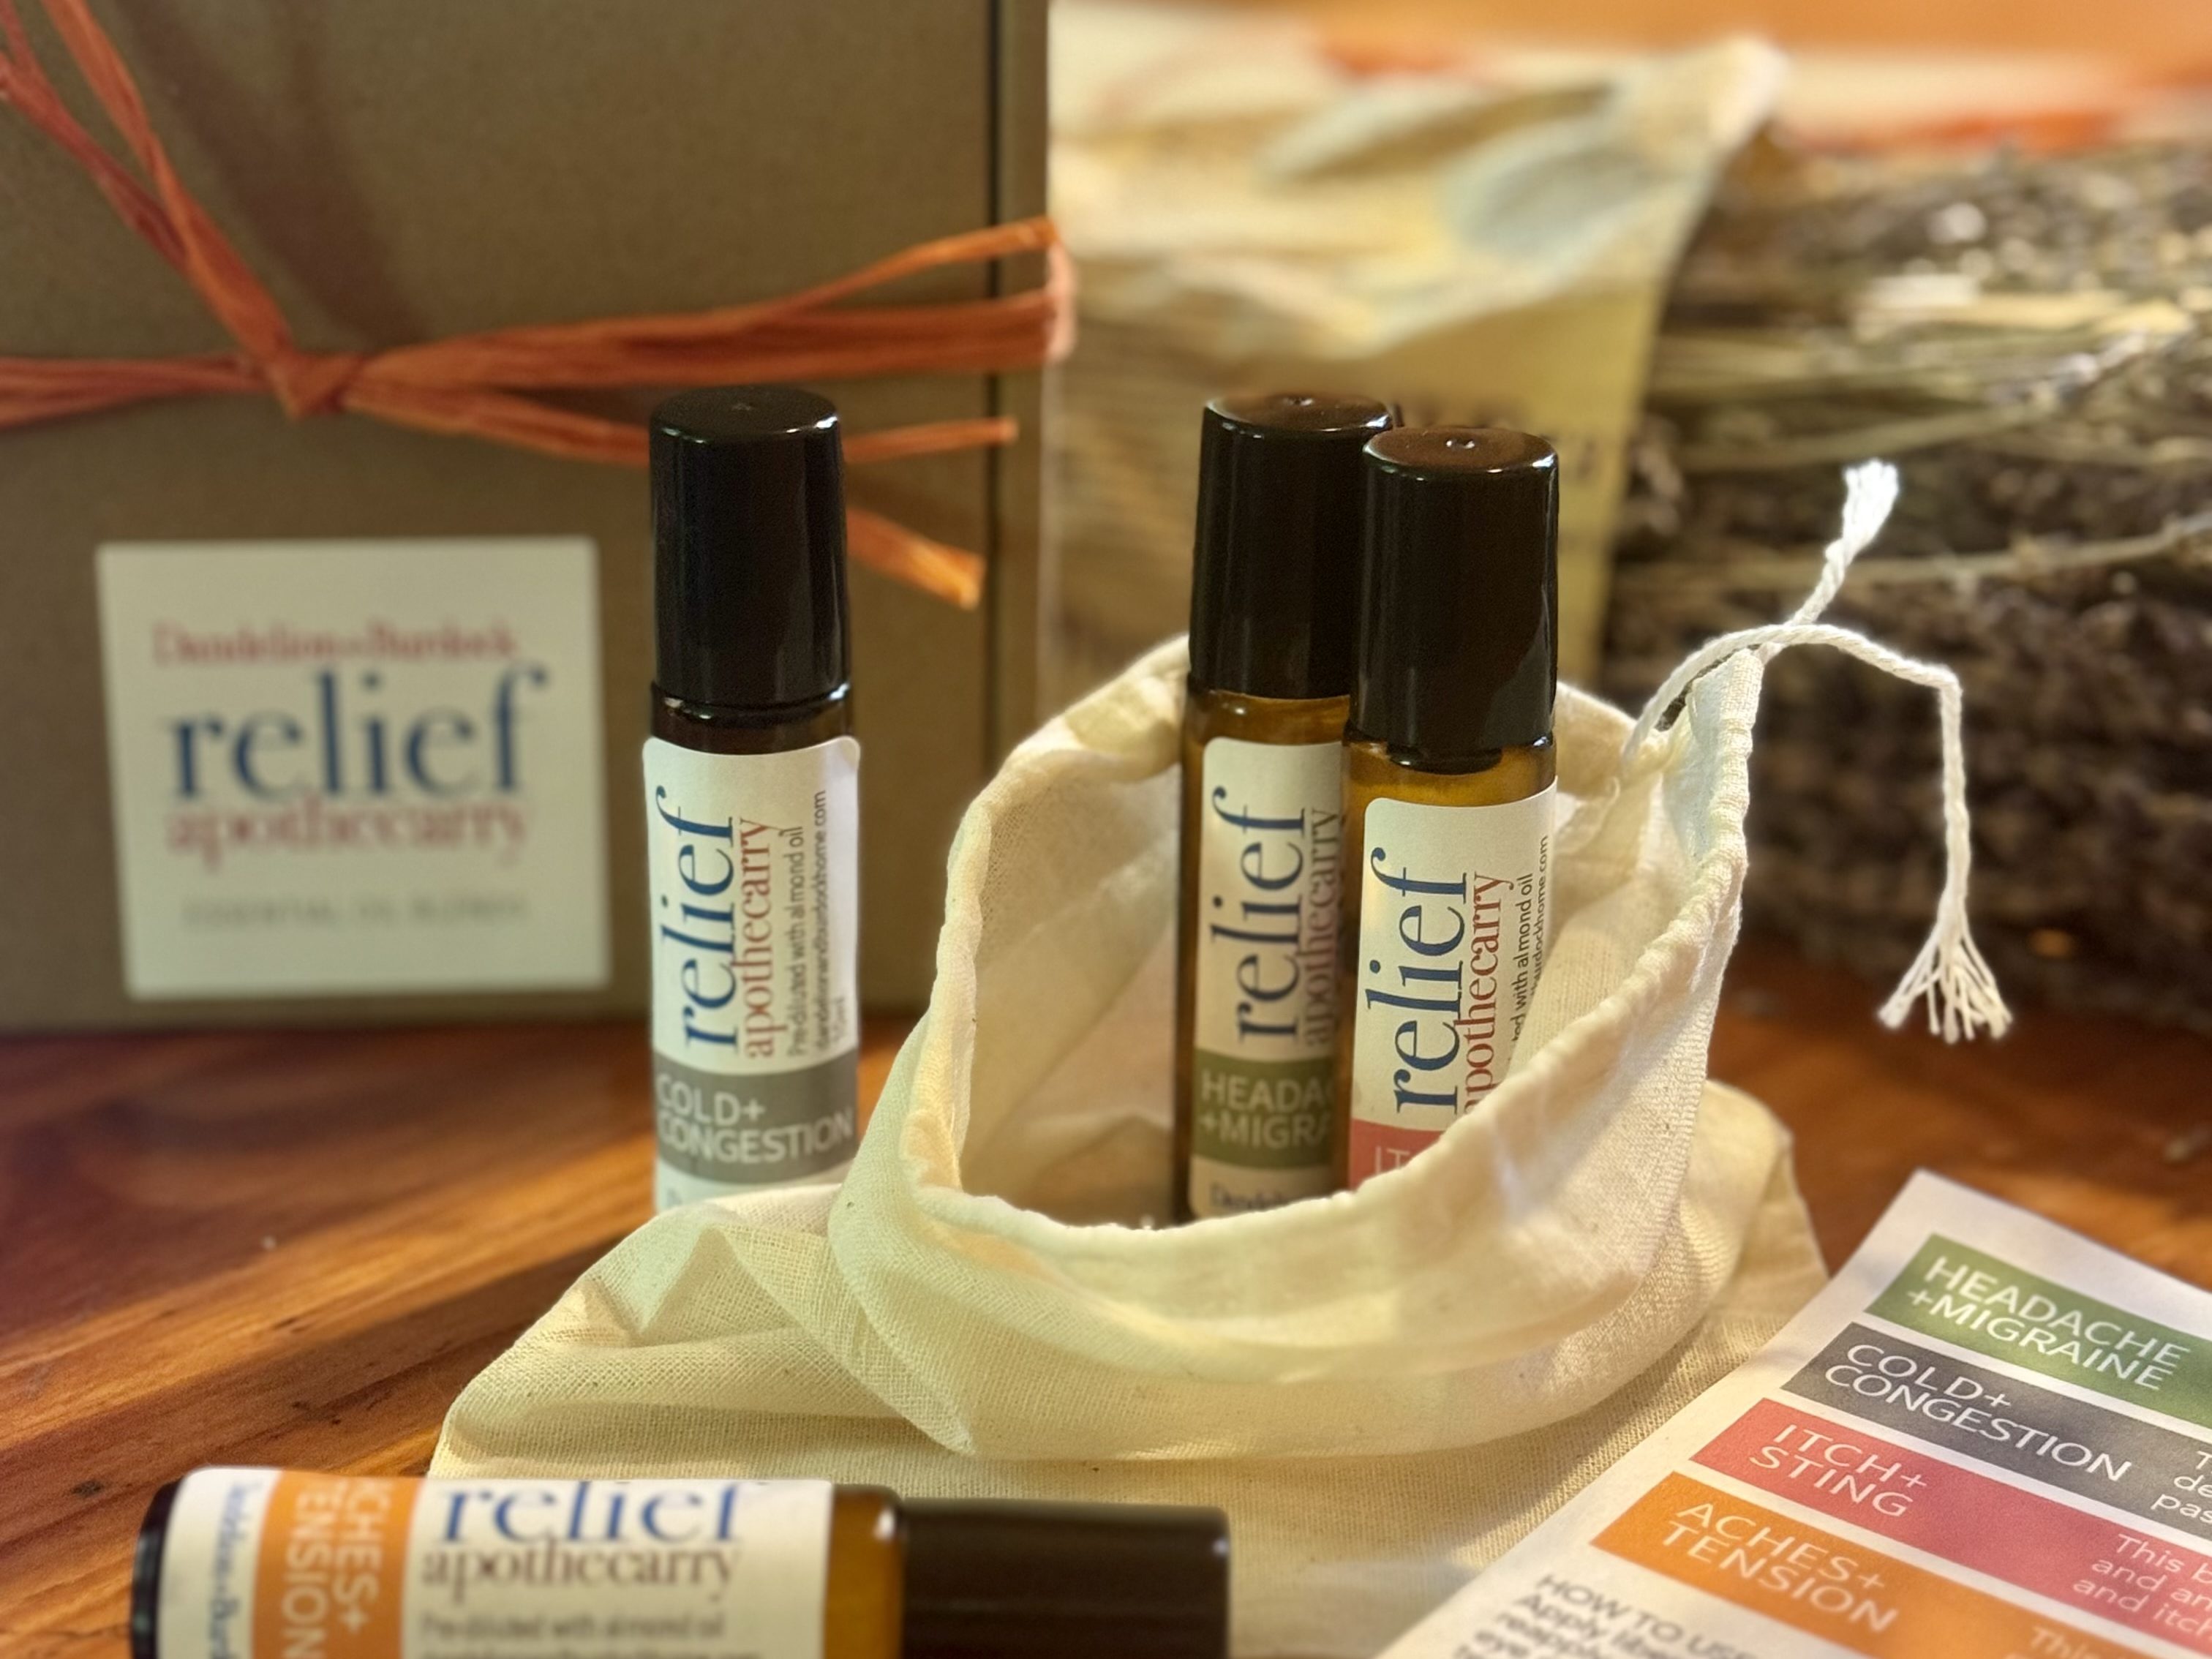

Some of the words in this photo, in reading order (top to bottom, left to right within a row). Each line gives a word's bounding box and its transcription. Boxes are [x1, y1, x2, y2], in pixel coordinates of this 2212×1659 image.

[171, 664, 551, 800] relief
[780, 827, 804, 847] oil
[783, 852, 805, 919] almond
[1209, 786, 1305, 1042] relief
[1516, 873, 1533, 896] oil
[655, 786, 738, 1055] relief
[733, 819, 788, 1059] apothecarry
[1513, 899, 1531, 960] almond
[1365, 847, 1467, 1114] relief
[1511, 971, 1528, 1010] with
[658, 1073, 766, 1127] COLD+
[659, 1107, 854, 1164] CONGESTION
[1906, 1289, 2175, 1391] +MIGRAINE
[1925, 1256, 2190, 1369] HEADACHE
[1846, 1344, 2012, 1407] COLD+
[1773, 1423, 1927, 1489] ITCH+
[1824, 1364, 2132, 1482] CONGESTION
[434, 1481, 765, 1545] relief
[1749, 1445, 1914, 1517] STING
[1662, 1520, 1900, 1633] TENSION
[1676, 1503, 1886, 1590] ACHES+
[2091, 1558, 2167, 1592] and
[2116, 1533, 2184, 1573] This
[1536, 1573, 1632, 1618] HOW
[1633, 1611, 1684, 1644] TO
[2072, 1579, 2150, 1612] and
